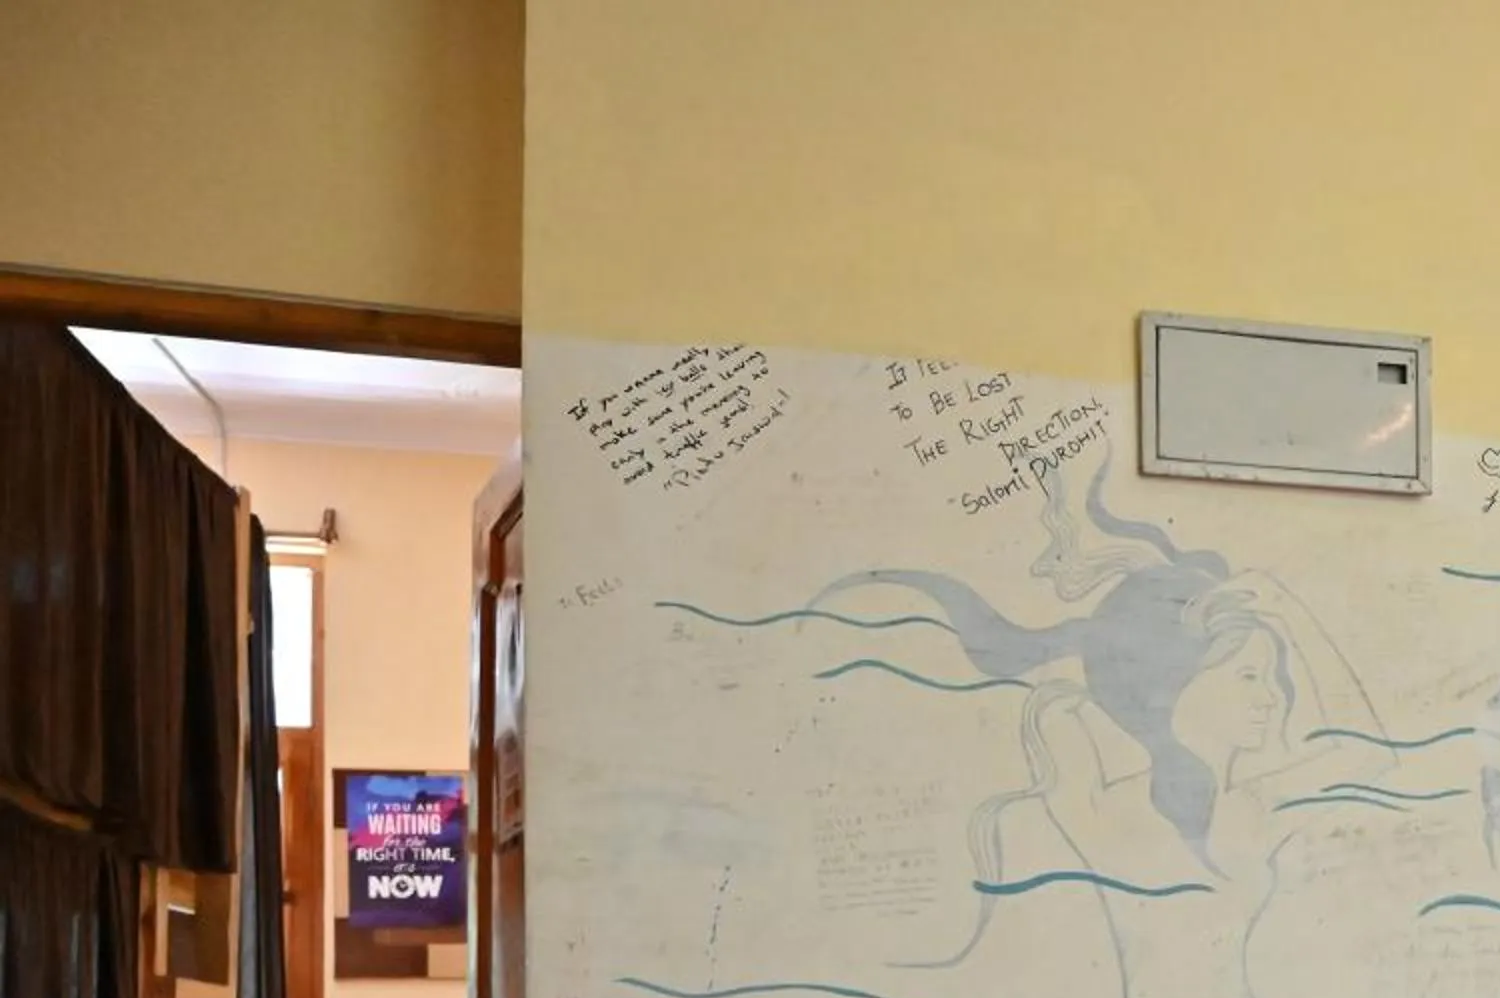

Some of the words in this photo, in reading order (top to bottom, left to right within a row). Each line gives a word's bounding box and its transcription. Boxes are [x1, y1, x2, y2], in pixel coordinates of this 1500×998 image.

[928, 390, 958, 416] BE
[963, 371, 1013, 403] LOST
[958, 395, 1025, 446] RIGHT
[383, 803, 412, 813] YOU
[416, 802, 442, 813] ARE
[367, 812, 442, 836] WAITING
[356, 847, 406, 862] RIGHT
[367, 873, 444, 899] NOW
